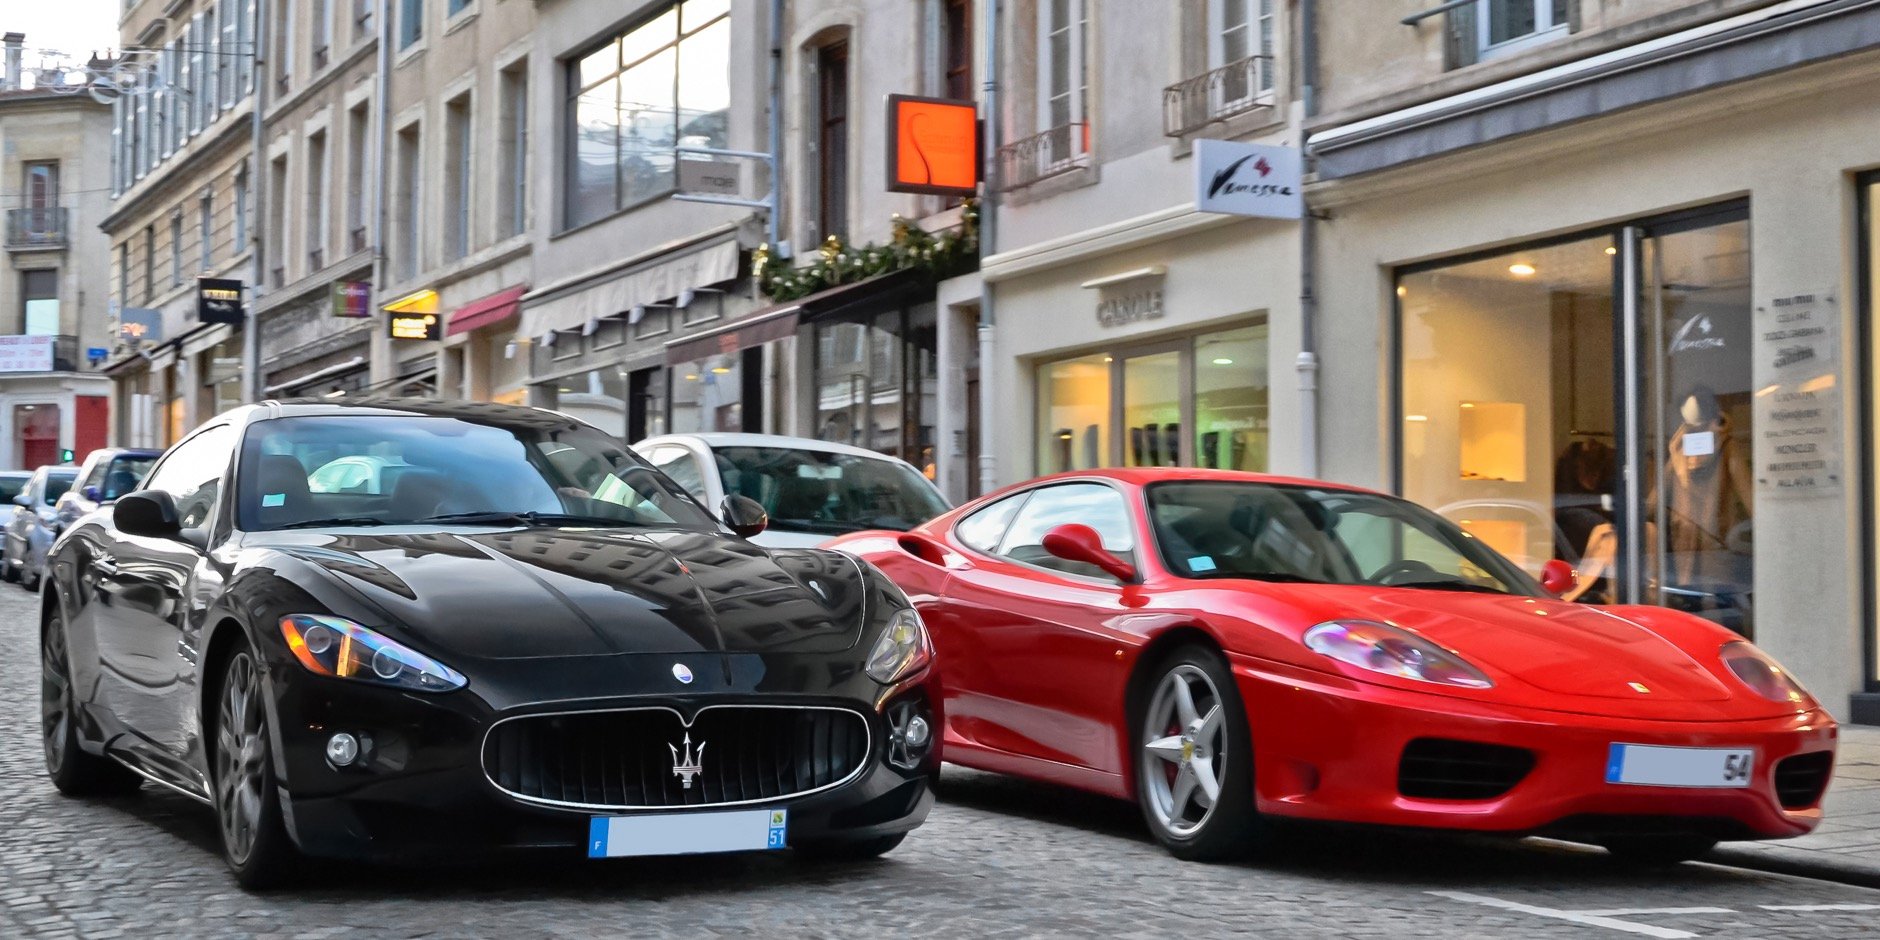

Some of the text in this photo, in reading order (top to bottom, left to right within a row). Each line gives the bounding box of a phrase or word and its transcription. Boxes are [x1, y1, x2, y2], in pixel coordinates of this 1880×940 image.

[1723, 754, 1751, 781] 54
[770, 830, 784, 845] 51
[595, 841, 601, 850] F
